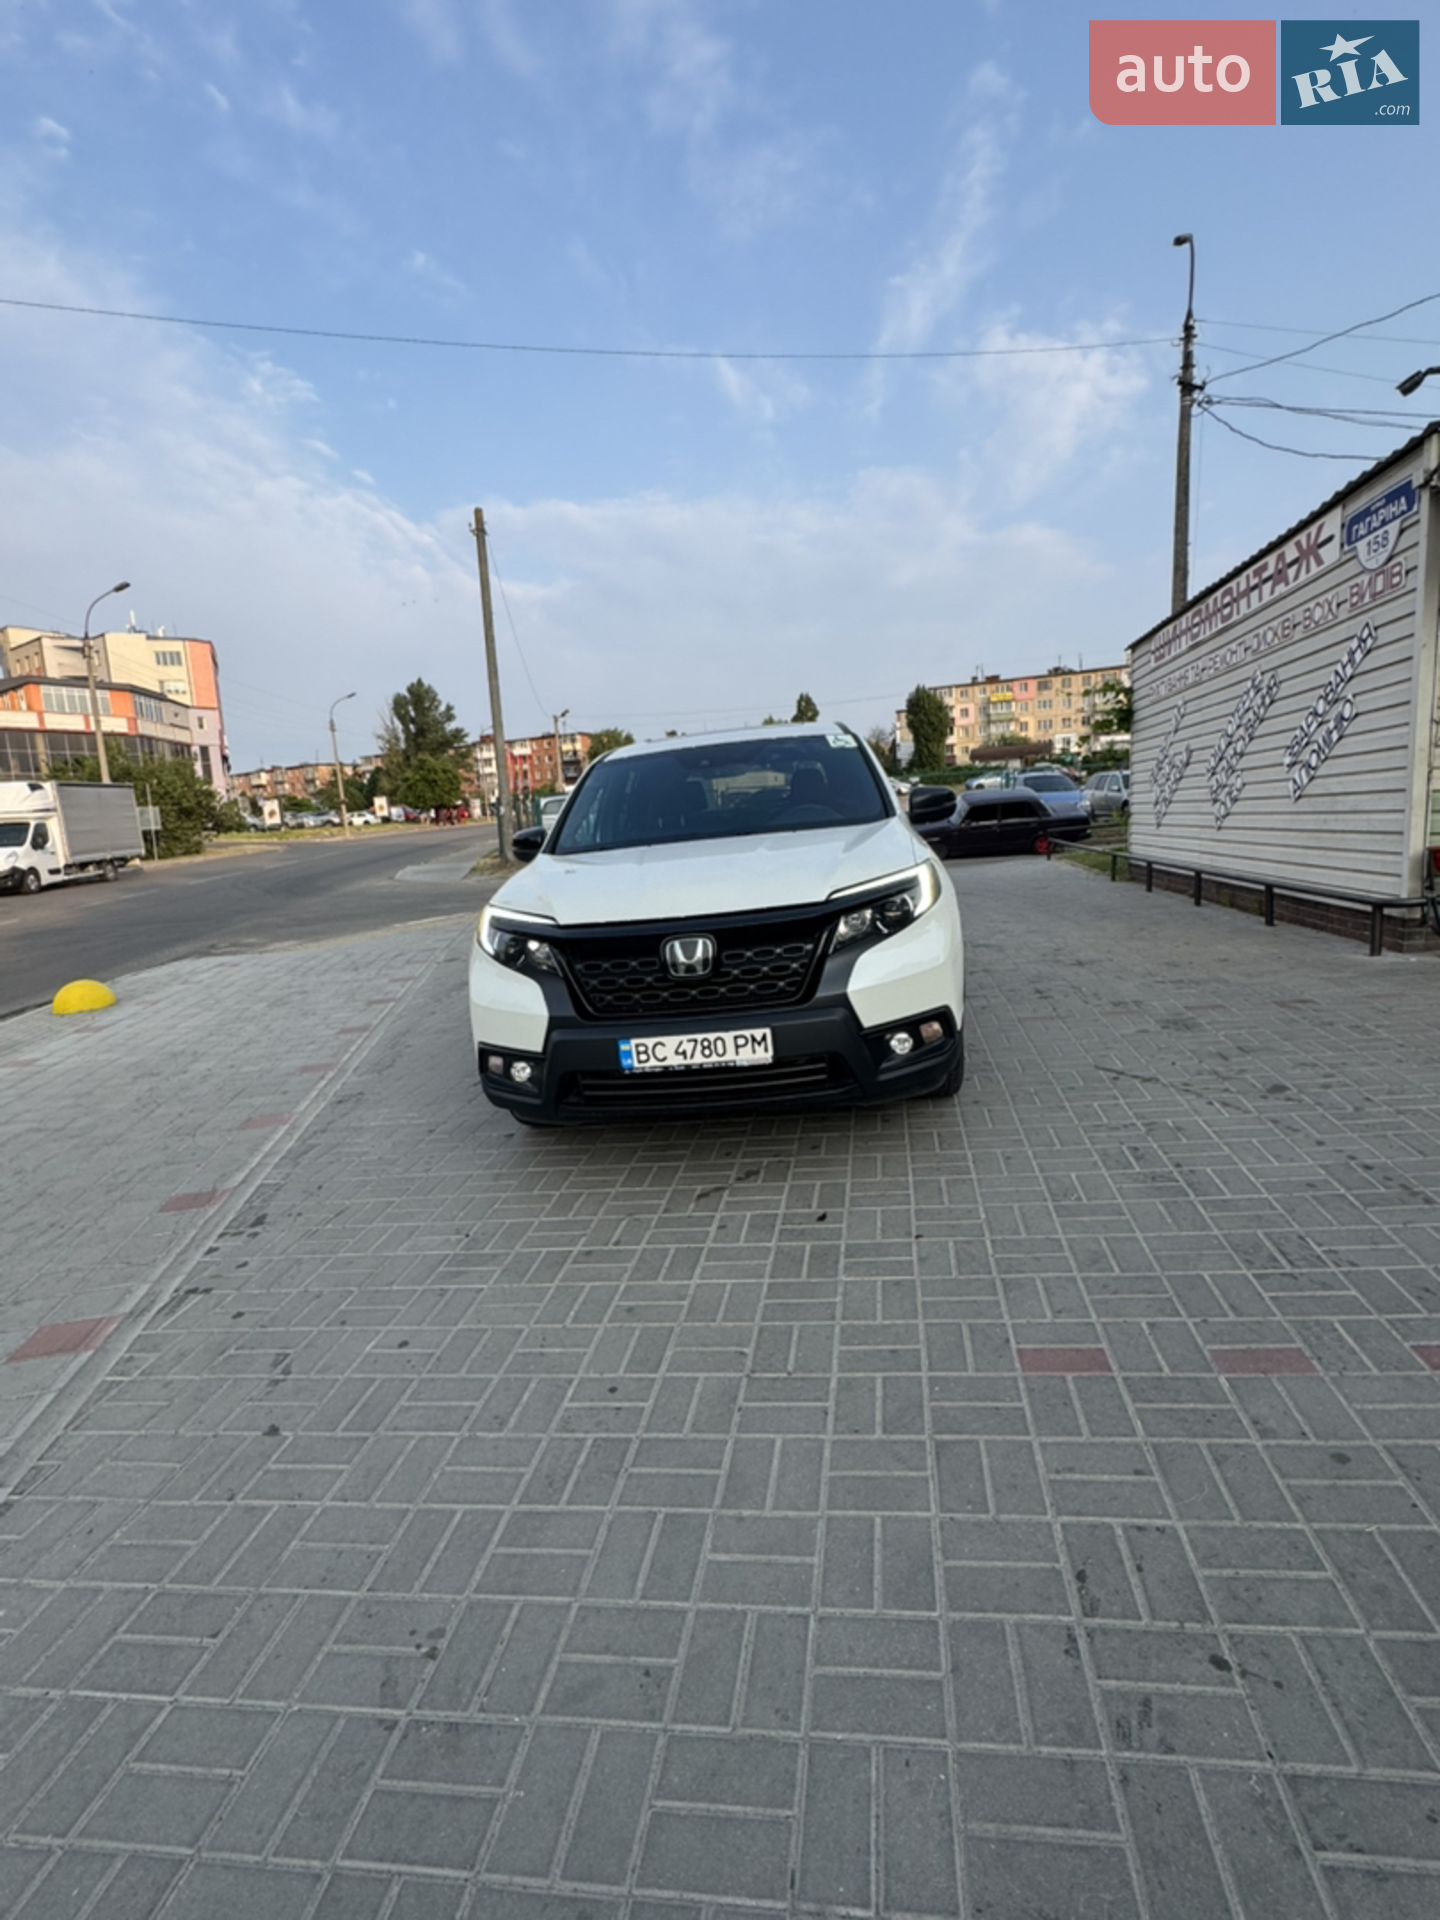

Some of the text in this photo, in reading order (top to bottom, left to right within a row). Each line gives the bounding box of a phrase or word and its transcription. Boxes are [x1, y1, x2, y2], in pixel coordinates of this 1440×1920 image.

[1351, 496, 1407, 541] ГАГАРІНА
[1366, 529, 1389, 556] 158
[1152, 521, 1326, 664] ШИНОМОНТАЖ
[1349, 561, 1402, 609] ВИДІВ
[634, 1032, 769, 1064] BC 4780 PM
